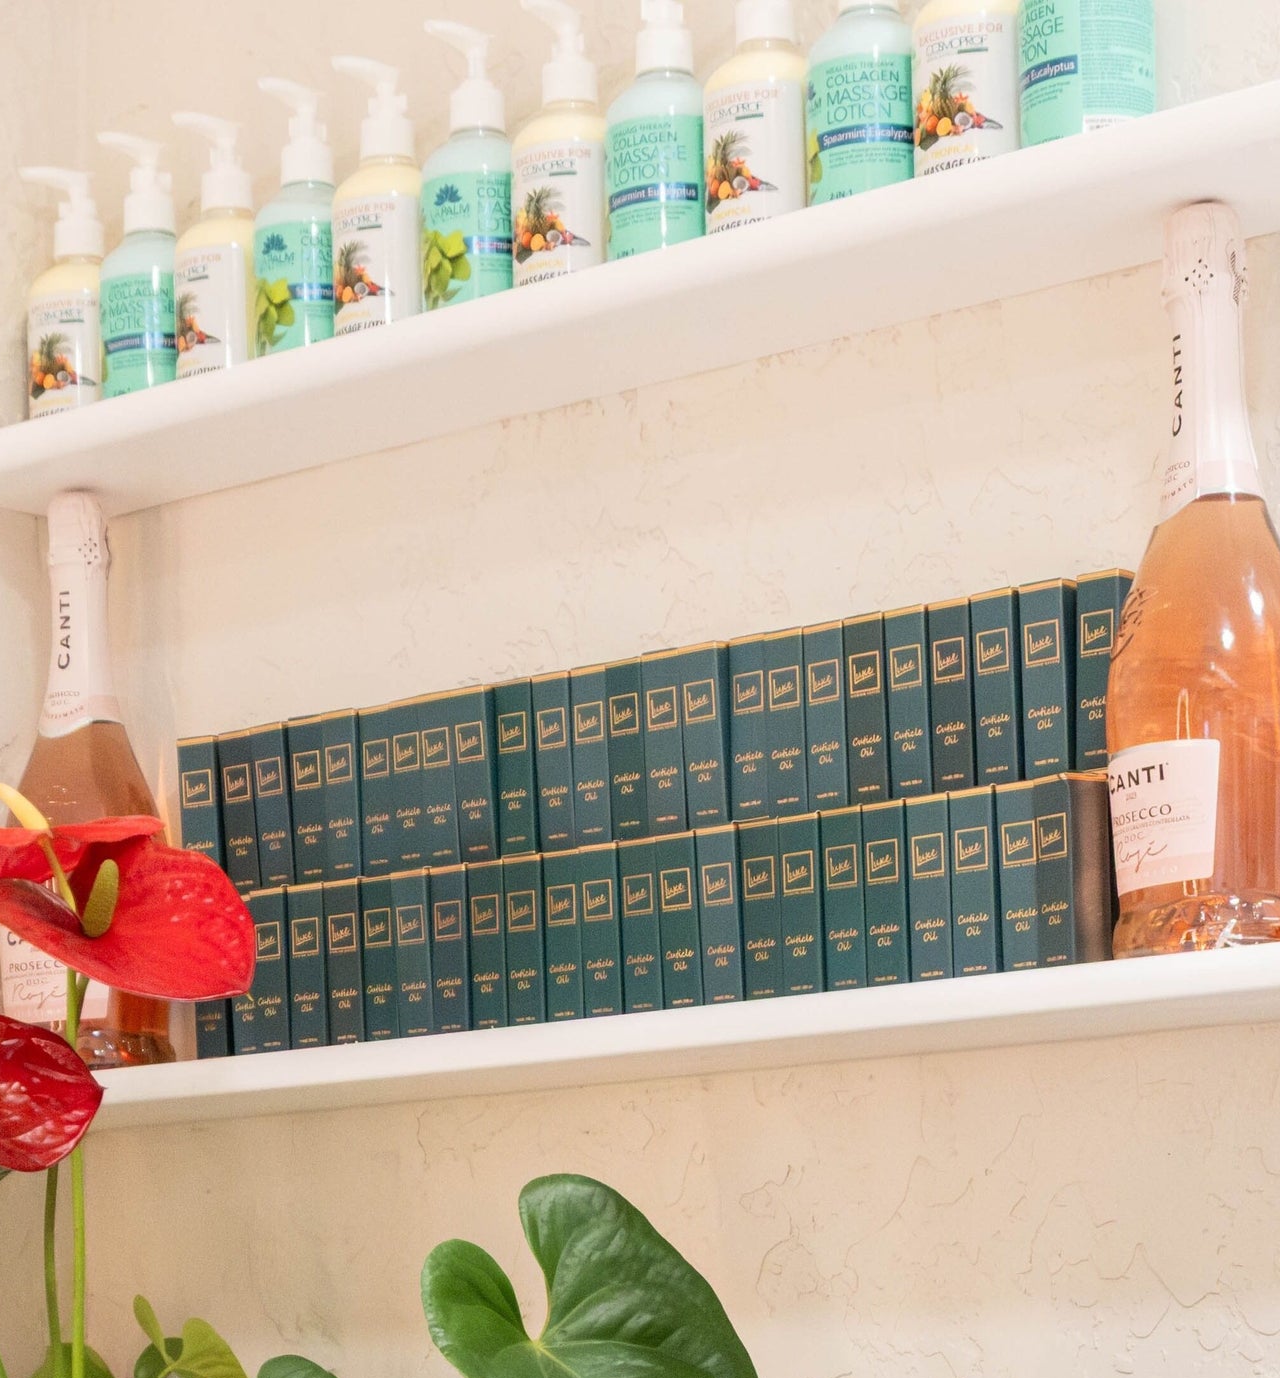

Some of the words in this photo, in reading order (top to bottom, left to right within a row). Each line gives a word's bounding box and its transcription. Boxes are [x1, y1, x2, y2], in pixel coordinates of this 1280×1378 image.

[978, 22, 1003, 34] FOR
[1030, 61, 1075, 82] Eucalyptus
[825, 70, 900, 89] COLLAGEN
[826, 85, 908, 107] MASSAGE
[827, 102, 892, 125] LOTION
[613, 131, 678, 152] COLLAGEN
[823, 129, 865, 147] Spearmint
[613, 145, 688, 169] MASSAGE
[614, 162, 670, 187] LOTION
[1172, 333, 1183, 437] CANTI
[57, 590, 71, 670] CANTI
[1081, 694, 1107, 709] Cuticl
[1028, 706, 1061, 719] Cuticle
[1089, 709, 1103, 720] Oil
[980, 713, 1010, 726] Cuticle
[1037, 718, 1053, 730] Oil
[936, 721, 965, 734] Cuticle
[988, 727, 1002, 737] Oil
[852, 734, 881, 746] Cuticle
[894, 728, 923, 740] Cuticle
[944, 735, 958, 745] Oil
[811, 741, 839, 754] Cuticle
[860, 747, 874, 757] Oil
[902, 741, 916, 752] Oil
[735, 751, 763, 763] Cuticle
[772, 748, 801, 759] Cuticle
[819, 754, 833, 764] Oil
[689, 760, 718, 771] Cuticle
[743, 763, 756, 773] Oil
[779, 760, 793, 770] Oil
[698, 772, 711, 782] Oil
[1109, 763, 1165, 794] CANTI
[1113, 803, 1172, 829] ROSECCO
[1042, 901, 1068, 914] Cuticle
[958, 913, 989, 925] Cuticle
[1006, 908, 1038, 920] Cuticle
[1049, 915, 1061, 925] Oil
[870, 924, 899, 935] Cuticle
[915, 918, 945, 930] Cuticle
[1015, 921, 1030, 932] Oil
[829, 928, 858, 940] Cuticle
[923, 931, 938, 942] Oil
[966, 926, 981, 936] Oil
[747, 938, 776, 950] Cuticle
[785, 934, 814, 945] Cuticle
[877, 937, 892, 947] Oil
[793, 947, 807, 956] Oil
[837, 941, 851, 951] Oil
[755, 952, 769, 961] Oil
[8, 959, 63, 973] PROSECC
